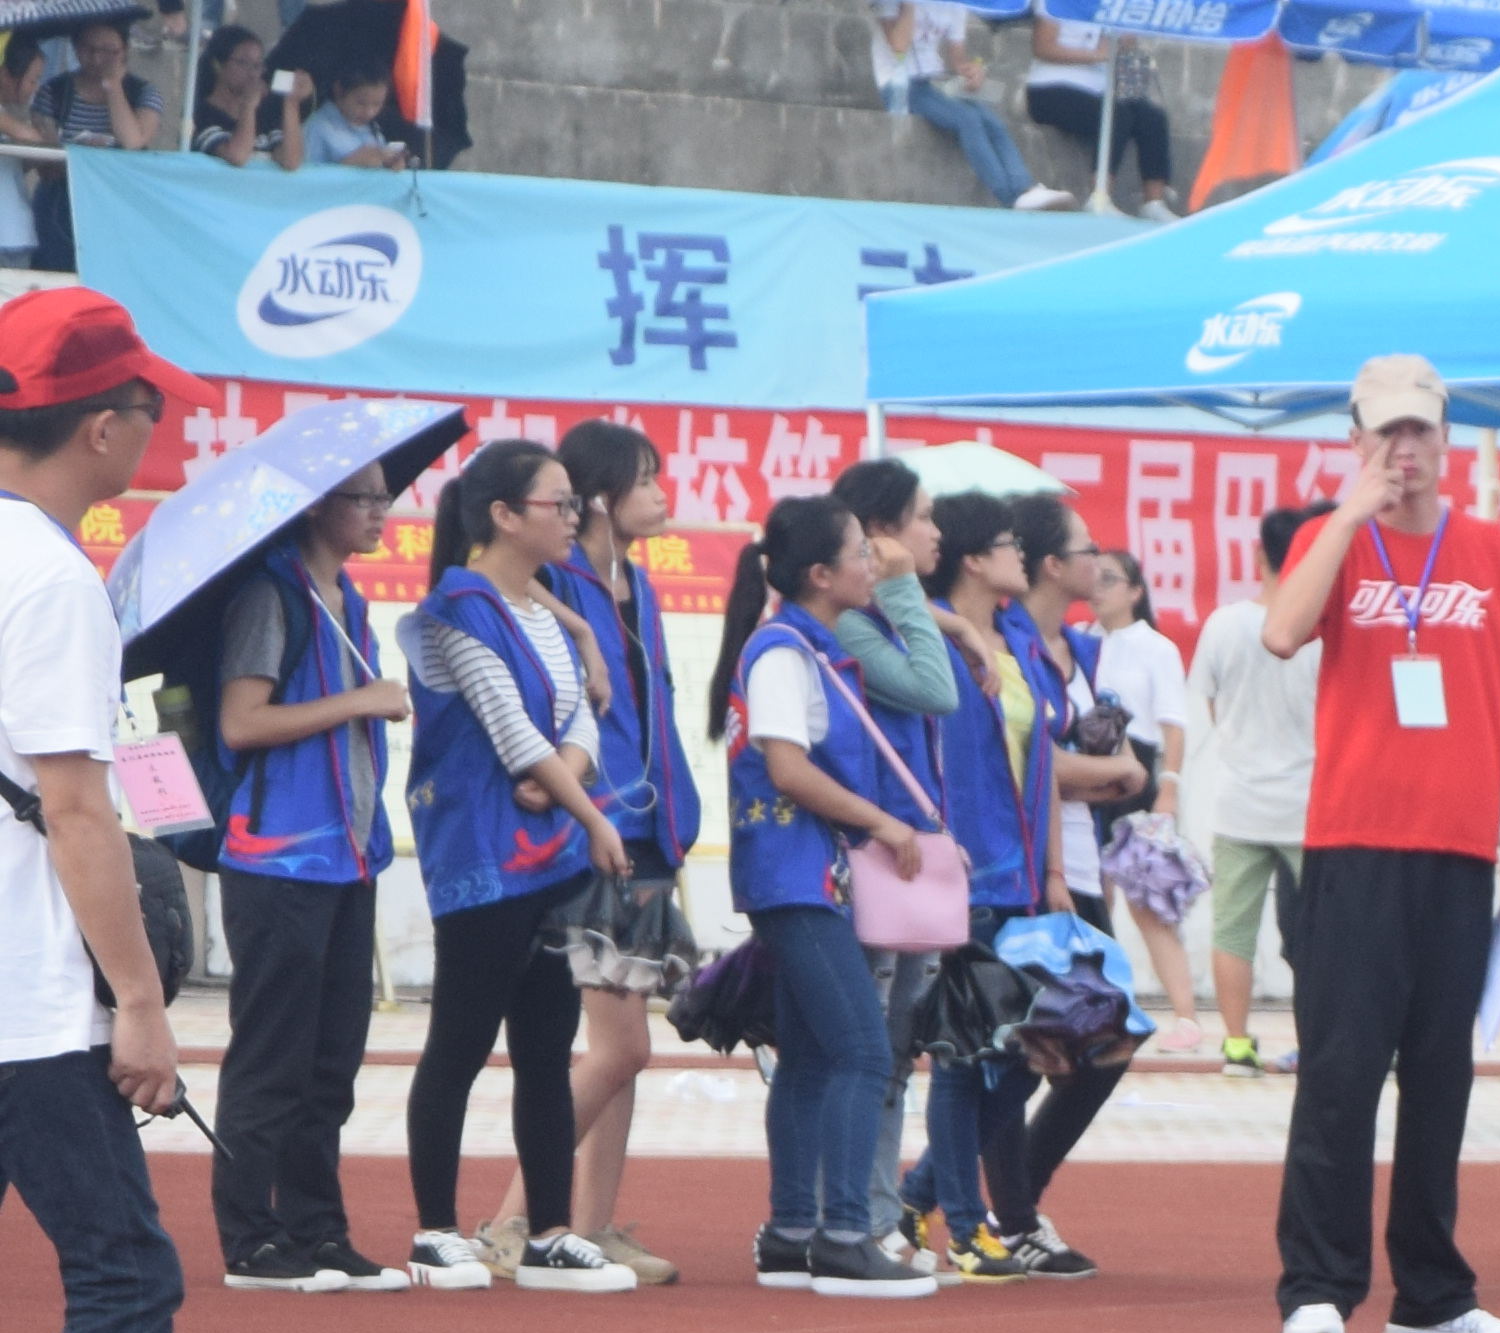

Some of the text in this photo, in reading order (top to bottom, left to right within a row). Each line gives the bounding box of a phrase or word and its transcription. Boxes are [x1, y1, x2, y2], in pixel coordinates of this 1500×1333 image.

[275, 251, 391, 302] 水动乐
[1201, 311, 1283, 347] 水动乐
